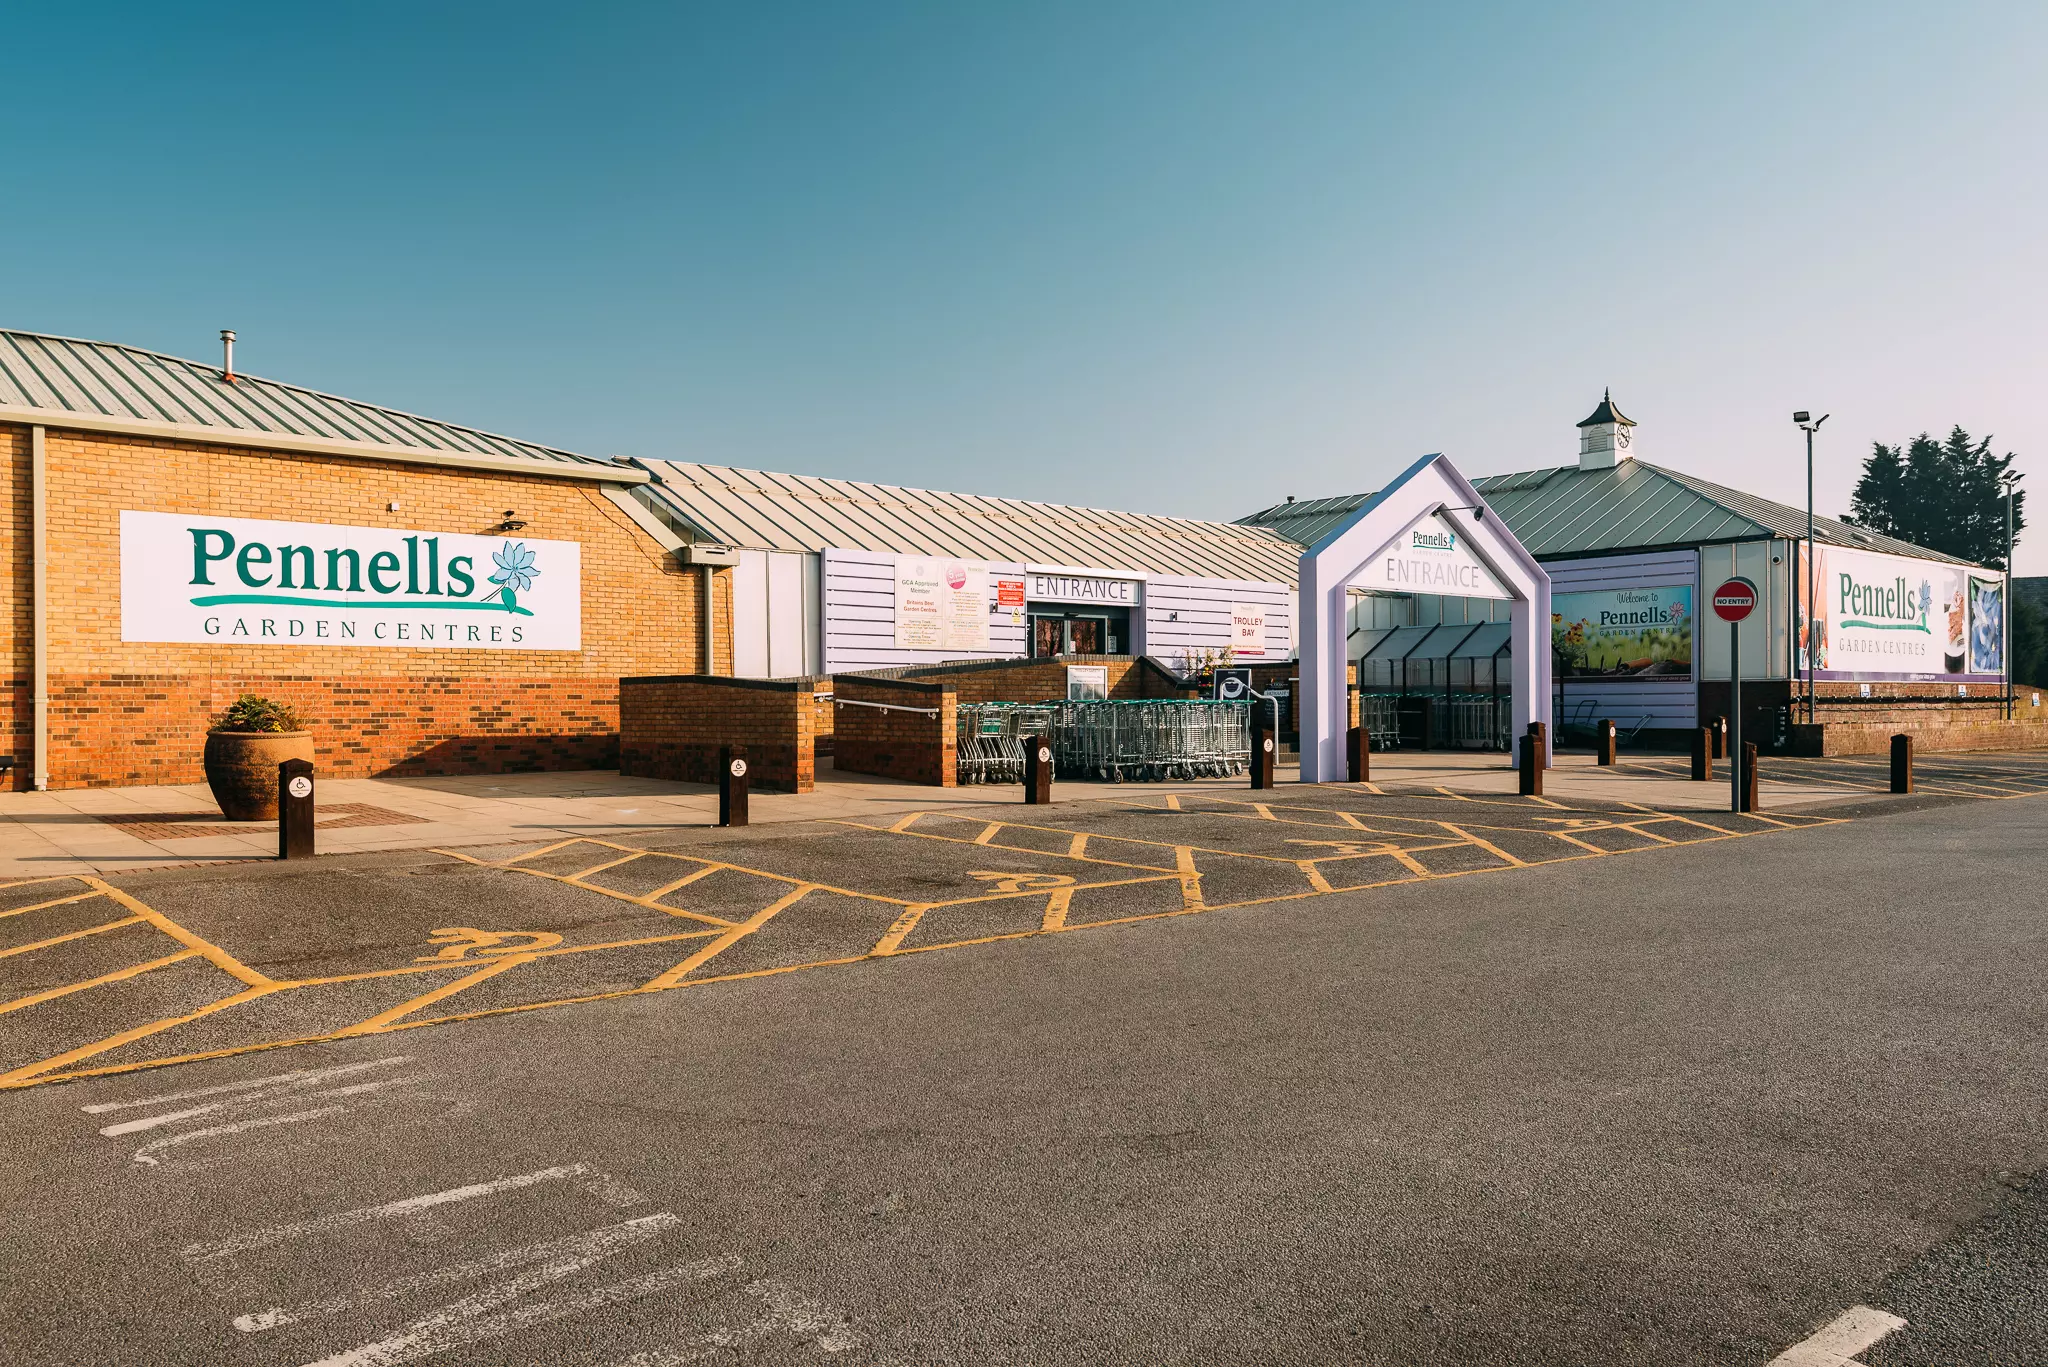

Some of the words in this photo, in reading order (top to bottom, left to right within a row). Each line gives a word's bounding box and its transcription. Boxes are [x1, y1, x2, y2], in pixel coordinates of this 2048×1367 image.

[1413, 531, 1447, 547] Pennells
[186, 528, 475, 598] Pennells
[1387, 558, 1479, 588] ENTRANCE
[914, 580, 939, 588] Approved
[1036, 576, 1128, 599] ENTRANCE
[1616, 592, 1650, 604] Welcome
[1651, 592, 1659, 602] to
[1839, 572, 1915, 621] Pennells
[1233, 616, 1264, 626] TROLLEY
[1600, 607, 1668, 625] Pennells
[204, 617, 356, 638] GARDEN
[374, 622, 523, 643] CENTRES
[1242, 628, 1255, 637] BAY
[1599, 628, 1637, 636] GARDEN
[1641, 627, 1683, 636] CENTRES
[1840, 638, 1881, 654] GARDEN
[1883, 640, 1926, 656] CENTRES
